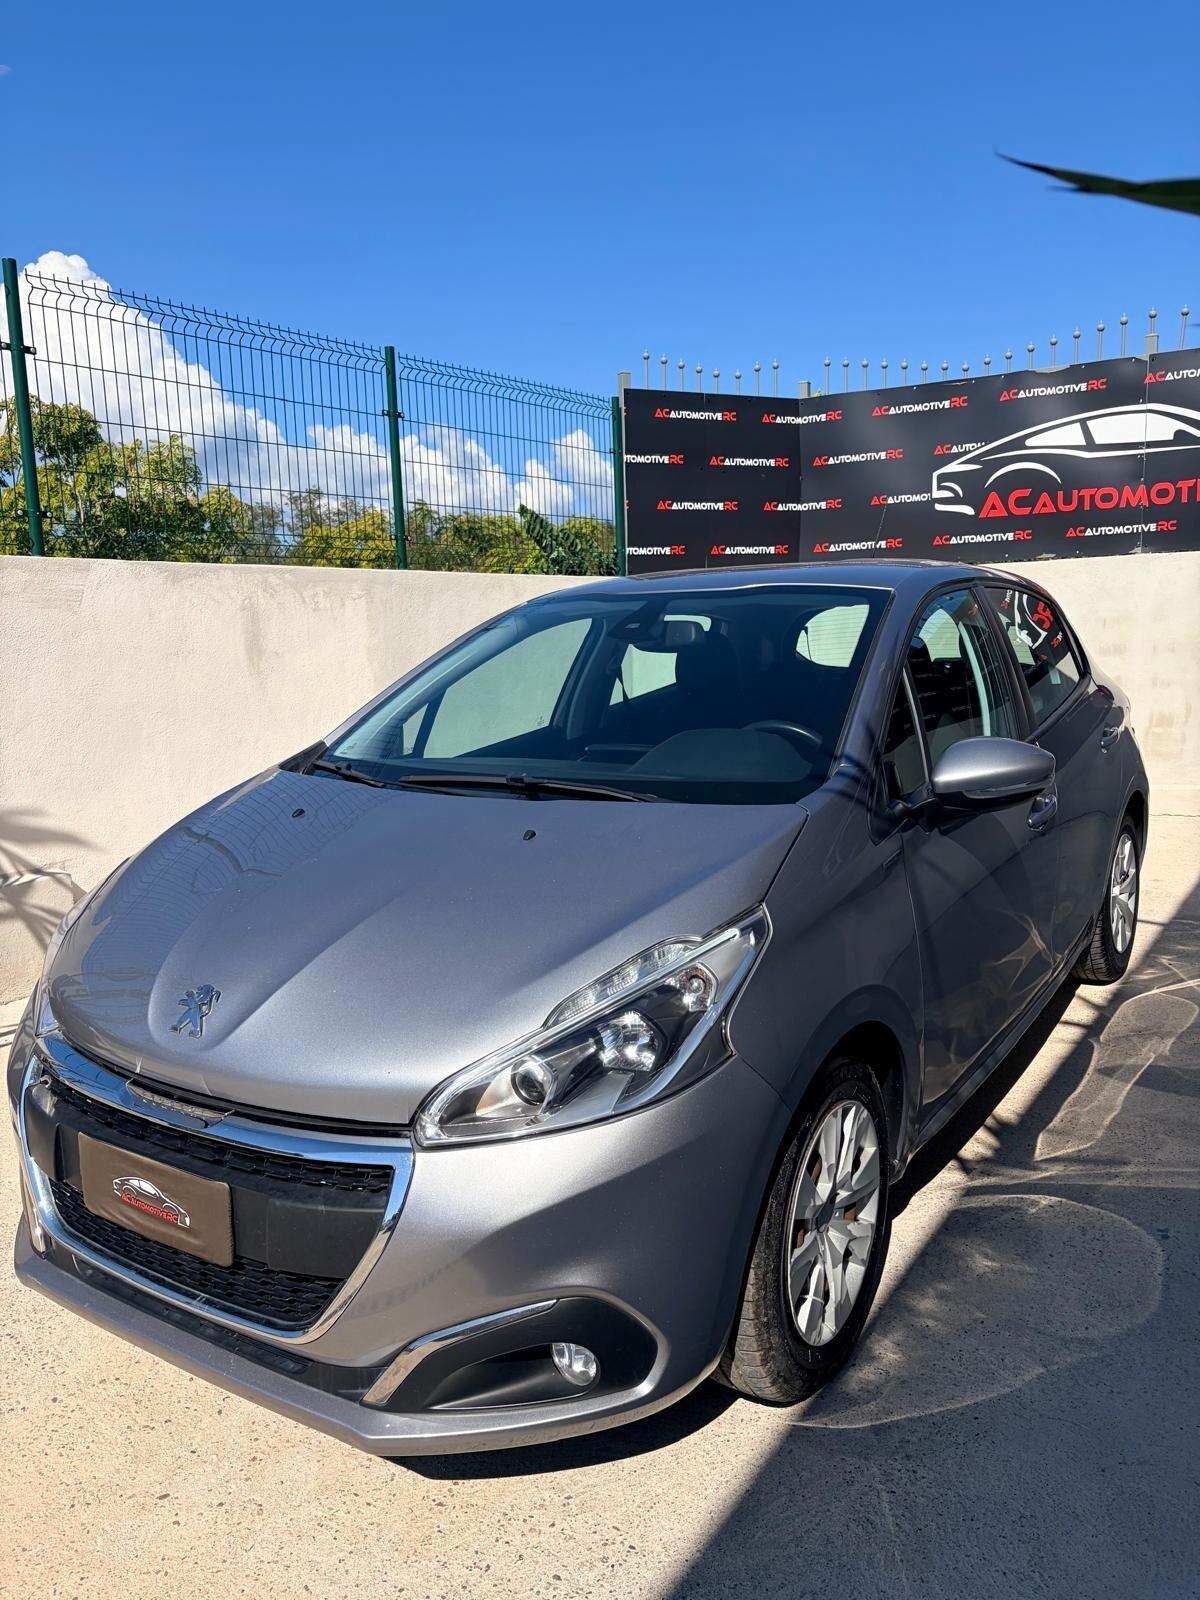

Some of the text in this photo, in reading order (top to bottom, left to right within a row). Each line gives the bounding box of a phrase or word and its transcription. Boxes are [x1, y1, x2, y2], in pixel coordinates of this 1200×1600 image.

[999, 378, 1107, 402] ACAUTOMOTIVERC
[872, 396, 968, 417] ACAUTOMOTIVERC
[654, 408, 737, 422] ACAUTOMOTIVERC
[761, 410, 842, 425] ACAUTOMOTIVERC
[709, 456, 789, 468] ACAUTOMOTIVERC
[812, 448, 904, 467] ACAUTOMOTIVERC
[656, 500, 738, 511] ACAUTOMOTIVERC
[763, 498, 842, 511] ACAUTOMOTIVERC
[1065, 520, 1177, 538] ACAUTOMOTIVERC
[933, 529, 1032, 546] ACAUTOMOTIVERC
[710, 544, 788, 555] ACAUTOMOTIVERC
